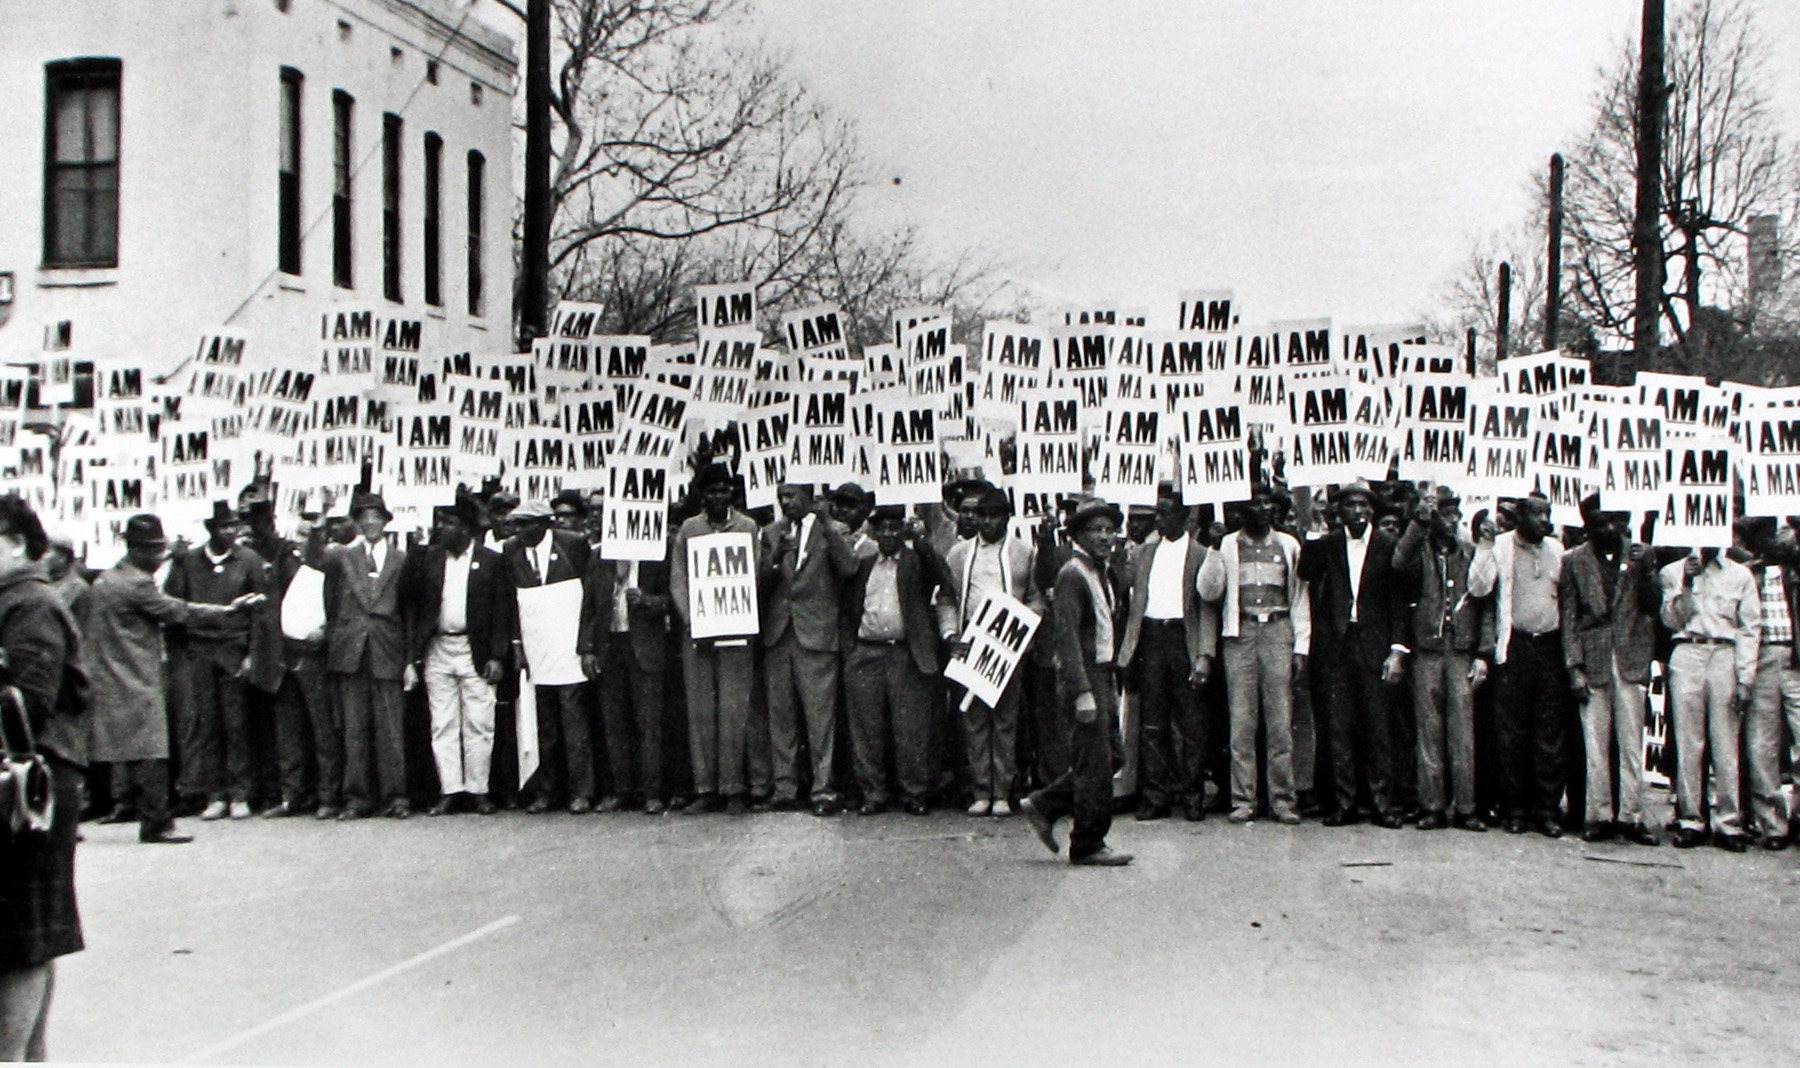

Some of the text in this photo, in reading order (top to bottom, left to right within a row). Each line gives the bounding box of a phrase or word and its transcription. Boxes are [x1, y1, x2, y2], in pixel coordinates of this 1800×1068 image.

[321, 311, 371, 340] I AM
[553, 311, 594, 339] I AM
[702, 293, 751, 328] I AM
[1180, 302, 1186, 330] I
[1191, 300, 1230, 332] AM
[383, 320, 421, 351] AM
[788, 313, 840, 350] I AM
[914, 328, 946, 361] AM
[196, 334, 245, 364] I AM
[321, 348, 370, 375] A MAN
[546, 344, 588, 371] A MAN
[595, 347, 602, 374] I
[608, 347, 646, 378] AM
[700, 340, 754, 371] I AM
[988, 333, 1041, 368] I AM
[1053, 336, 1105, 370] I AM
[1146, 342, 1153, 373] I
[1160, 342, 1203, 376] AM
[1236, 336, 1242, 364] I
[1273, 330, 1329, 366] I AM
[97, 368, 142, 399] I AM
[273, 370, 314, 402] AM
[383, 356, 418, 386] MAN
[984, 372, 992, 399] A
[1518, 363, 1556, 396] AM
[460, 389, 501, 422] AM
[694, 376, 702, 401] A
[710, 376, 748, 404] MAN
[1406, 385, 1466, 422] I AM
[266, 406, 301, 438] MAN
[312, 400, 318, 429] I
[322, 396, 358, 430] AM
[564, 401, 613, 435] I AM
[630, 391, 642, 418] I
[641, 394, 686, 430] AM
[793, 394, 799, 424] I
[806, 393, 844, 428] AM
[1021, 400, 1077, 434] I AM
[1289, 388, 1347, 426] I AM
[1469, 404, 1529, 440] I AM
[397, 417, 403, 446] I
[410, 416, 450, 448] AM
[460, 426, 497, 456] MAN
[742, 422, 750, 452] I
[877, 412, 884, 443] I
[892, 410, 933, 445] AM
[1106, 411, 1158, 445] I AM
[1183, 406, 1240, 444] I AM
[1603, 418, 1660, 451] I AM
[1745, 421, 1752, 452] I
[161, 432, 208, 464] I AM
[310, 441, 317, 467] A
[325, 437, 356, 466] MAN
[513, 440, 562, 469] I AM
[568, 443, 576, 471] A
[618, 429, 673, 457] A MAN
[791, 435, 844, 464] A MAN
[1022, 442, 1077, 473] A MAN
[1293, 431, 1350, 466] A MAN
[1404, 429, 1464, 462] A MAN
[1533, 431, 1581, 469] I AM
[398, 457, 450, 486] A MAN
[750, 461, 758, 489] A
[880, 451, 935, 485] A MAN
[1102, 452, 1155, 485] A MAN
[1188, 450, 1244, 484] A MAN
[1468, 448, 1526, 478] A MAN
[1606, 460, 1615, 490] A
[1666, 450, 1728, 486] I AM
[1750, 464, 1759, 494] A
[91, 480, 97, 507] I
[105, 480, 141, 510] AM
[177, 472, 207, 499] MAN
[610, 467, 665, 502] I AM
[608, 510, 662, 541] A MAN
[1665, 494, 1727, 526] A MAN
[694, 546, 748, 578] I AM
[697, 587, 751, 617] A MAN
[975, 600, 1029, 653] I AM
[973, 645, 1011, 688] MAN
